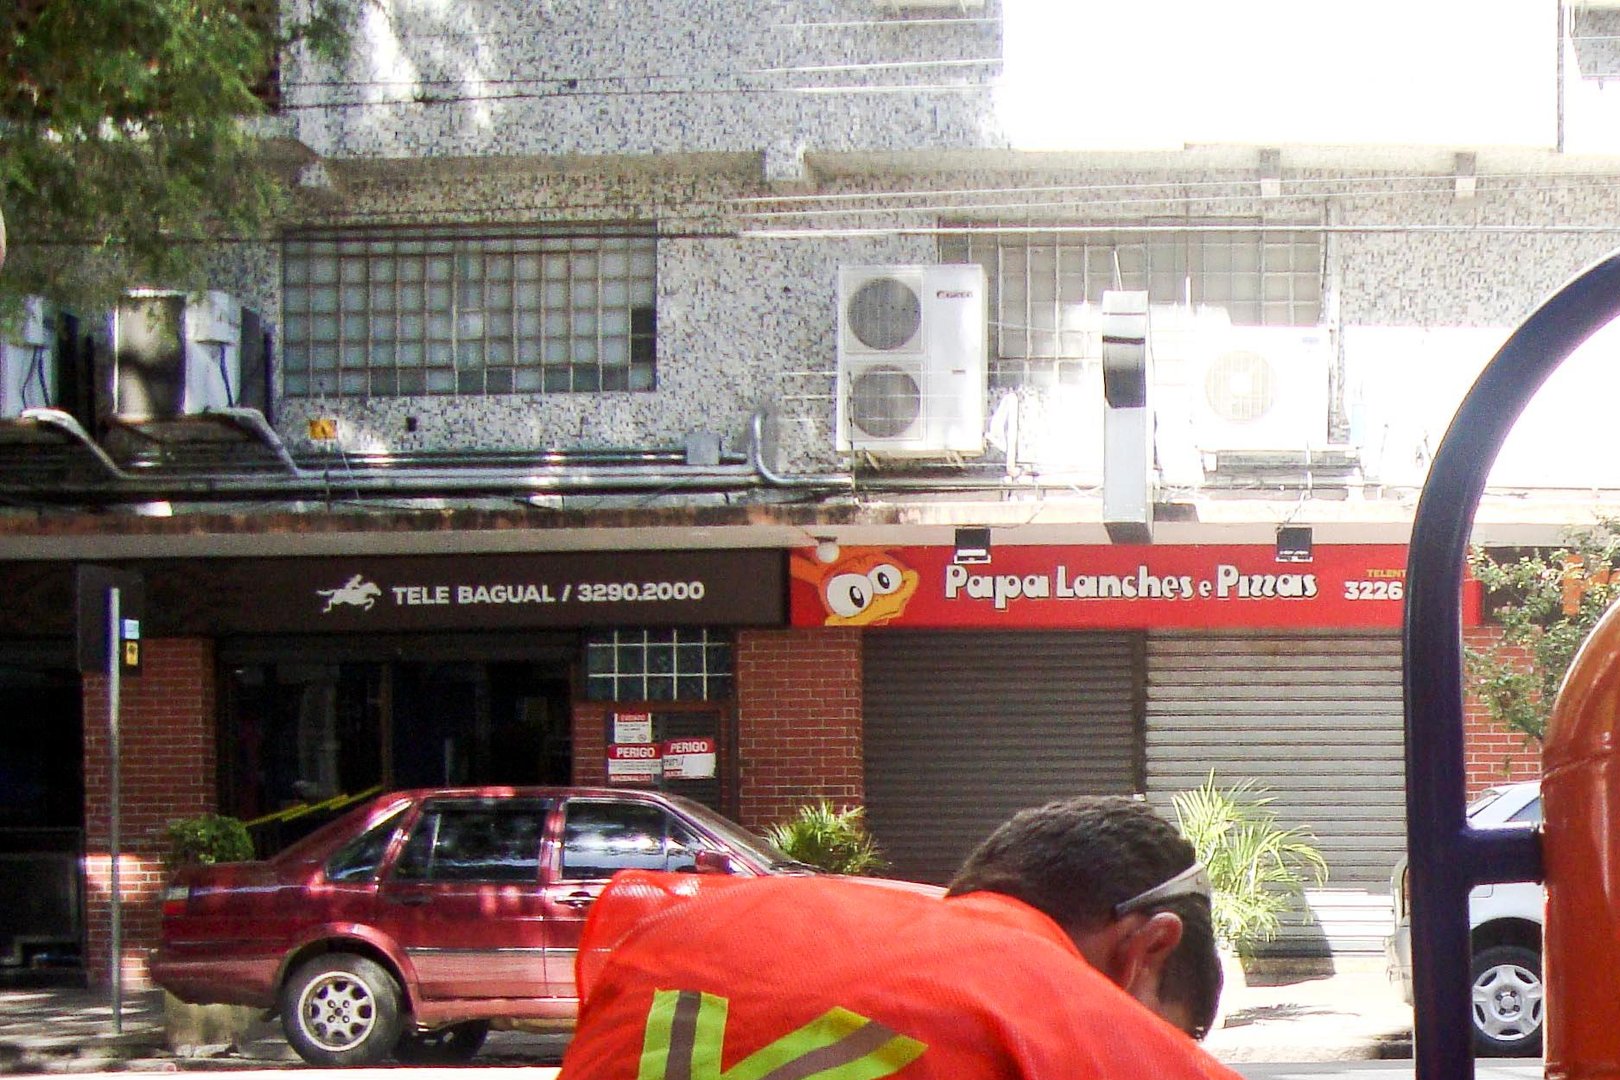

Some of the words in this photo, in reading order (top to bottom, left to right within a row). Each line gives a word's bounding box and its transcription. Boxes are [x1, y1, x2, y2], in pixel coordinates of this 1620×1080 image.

[391, 585, 450, 605] TELE
[457, 584, 555, 604] BAGUAL
[577, 581, 706, 602] 3290.2000
[945, 564, 1051, 609] Papa
[1055, 564, 1194, 600] Lanches
[1199, 577, 1212, 599] e
[1216, 564, 1319, 600] Pizzas
[1343, 580, 1404, 601] 3226
[616, 747, 656, 758] PERIGO
[670, 741, 708, 753] PERIGO
